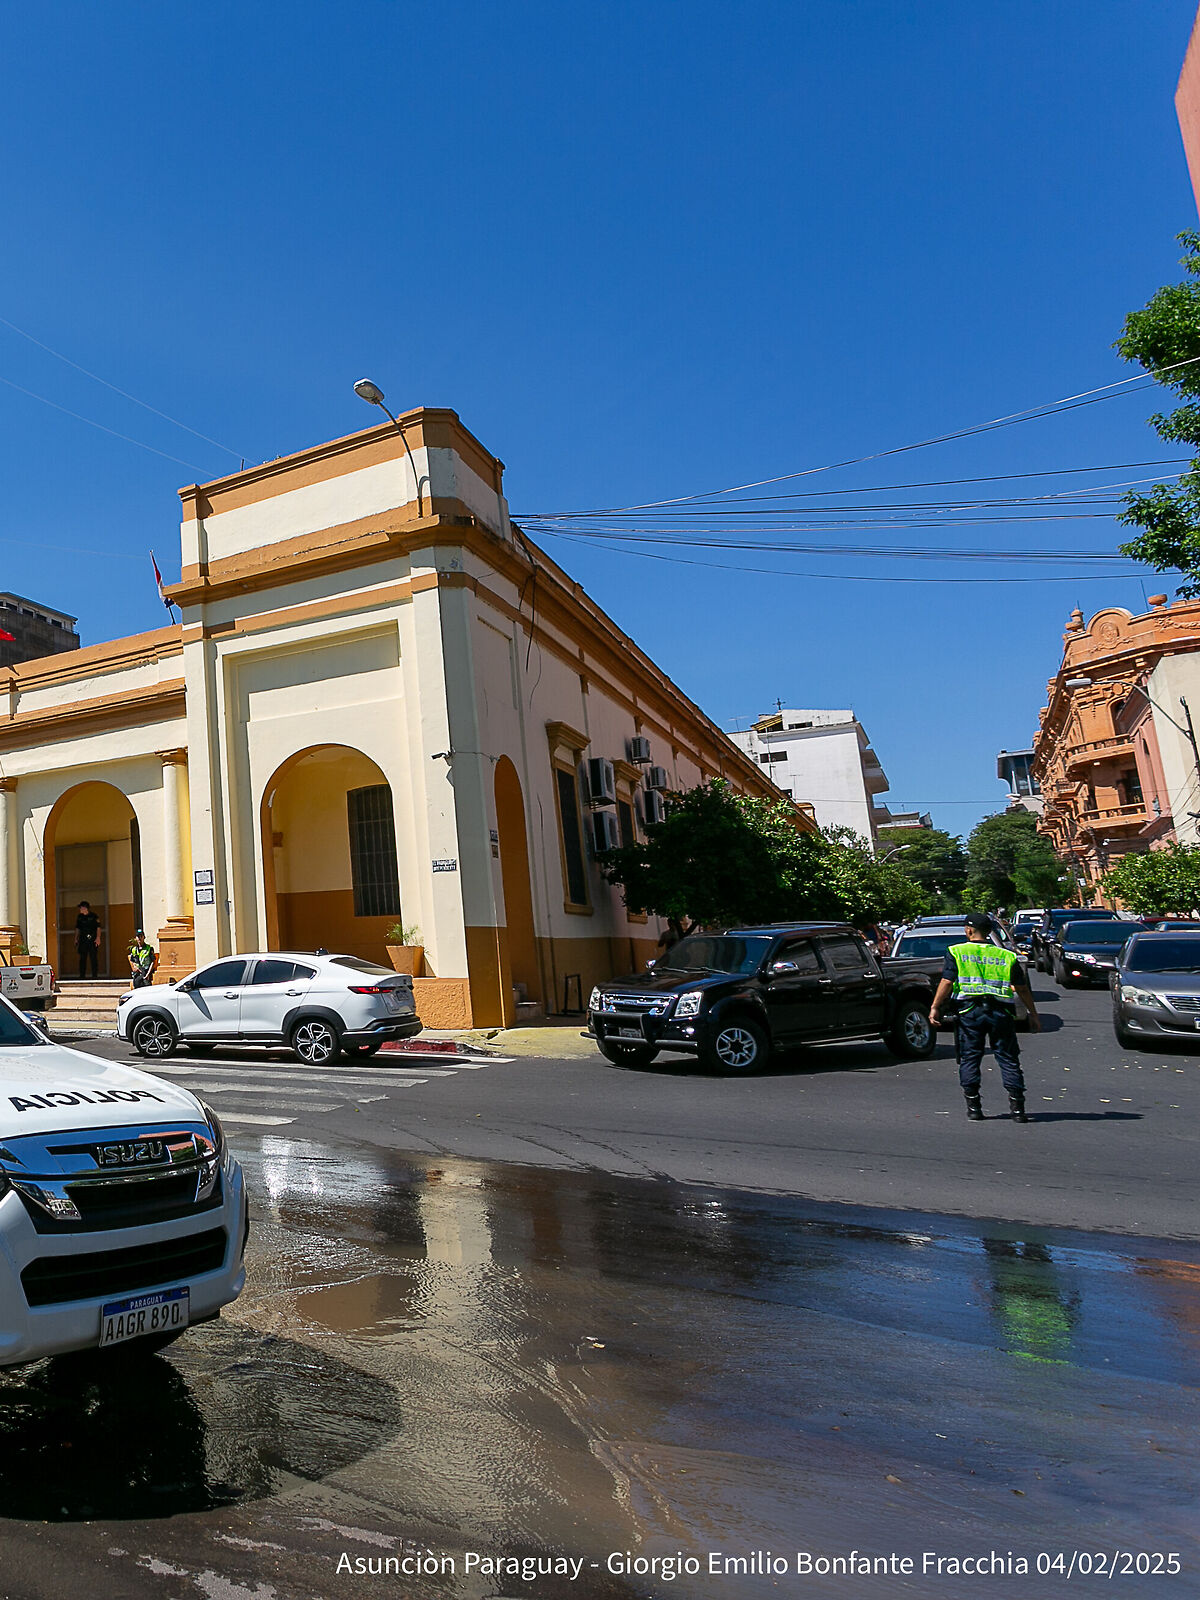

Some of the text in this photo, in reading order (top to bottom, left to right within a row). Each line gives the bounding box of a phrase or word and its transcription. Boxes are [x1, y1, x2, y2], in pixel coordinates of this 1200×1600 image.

[961, 954, 1007, 966] POLICIA
[96, 1141, 163, 1165] ISUZU
[130, 1295, 164, 1309] PARAGUAY
[105, 1303, 180, 1342] AAGR 890
